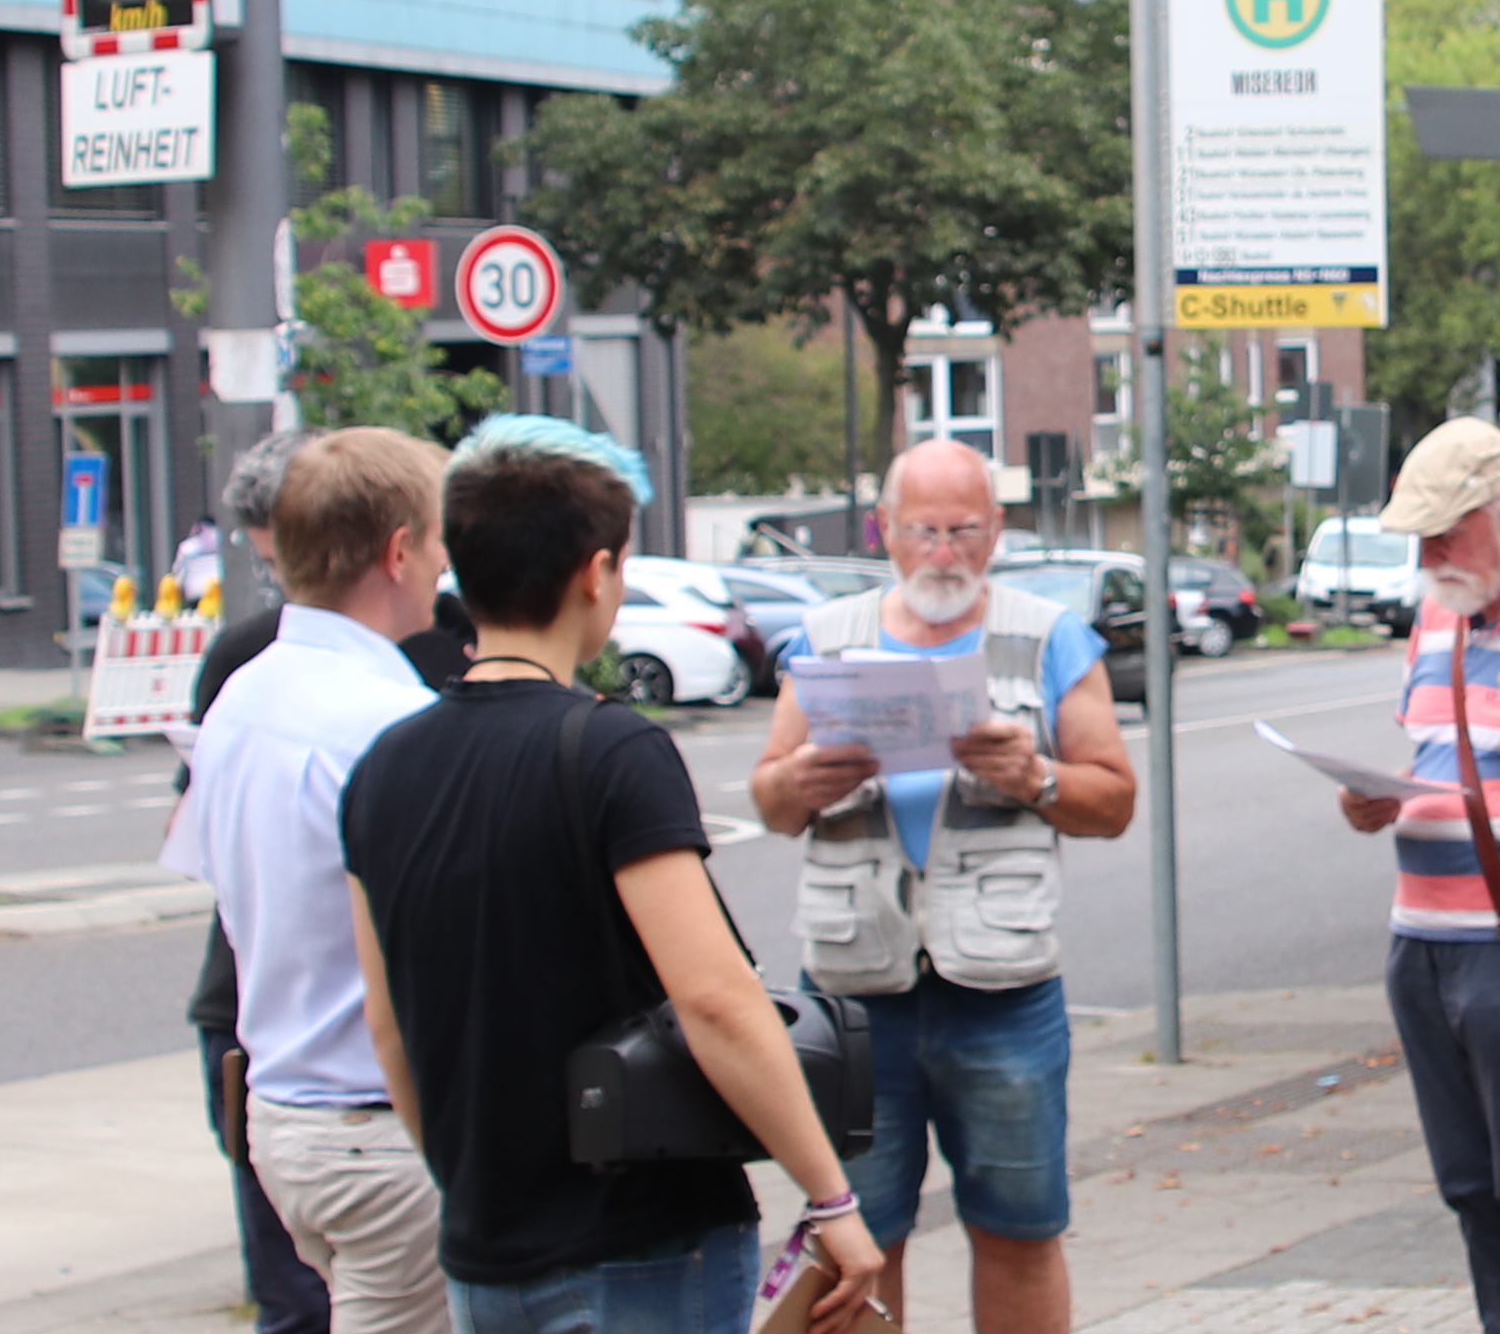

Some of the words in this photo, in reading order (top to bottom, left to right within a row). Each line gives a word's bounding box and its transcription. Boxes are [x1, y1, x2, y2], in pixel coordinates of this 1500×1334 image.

[95, 66, 171, 108] LUFT-
[1231, 69, 1318, 94] MISEREOR
[73, 127, 198, 173] REINHEIT
[481, 262, 535, 308] 30
[1181, 293, 1308, 318] C-Shuttle
